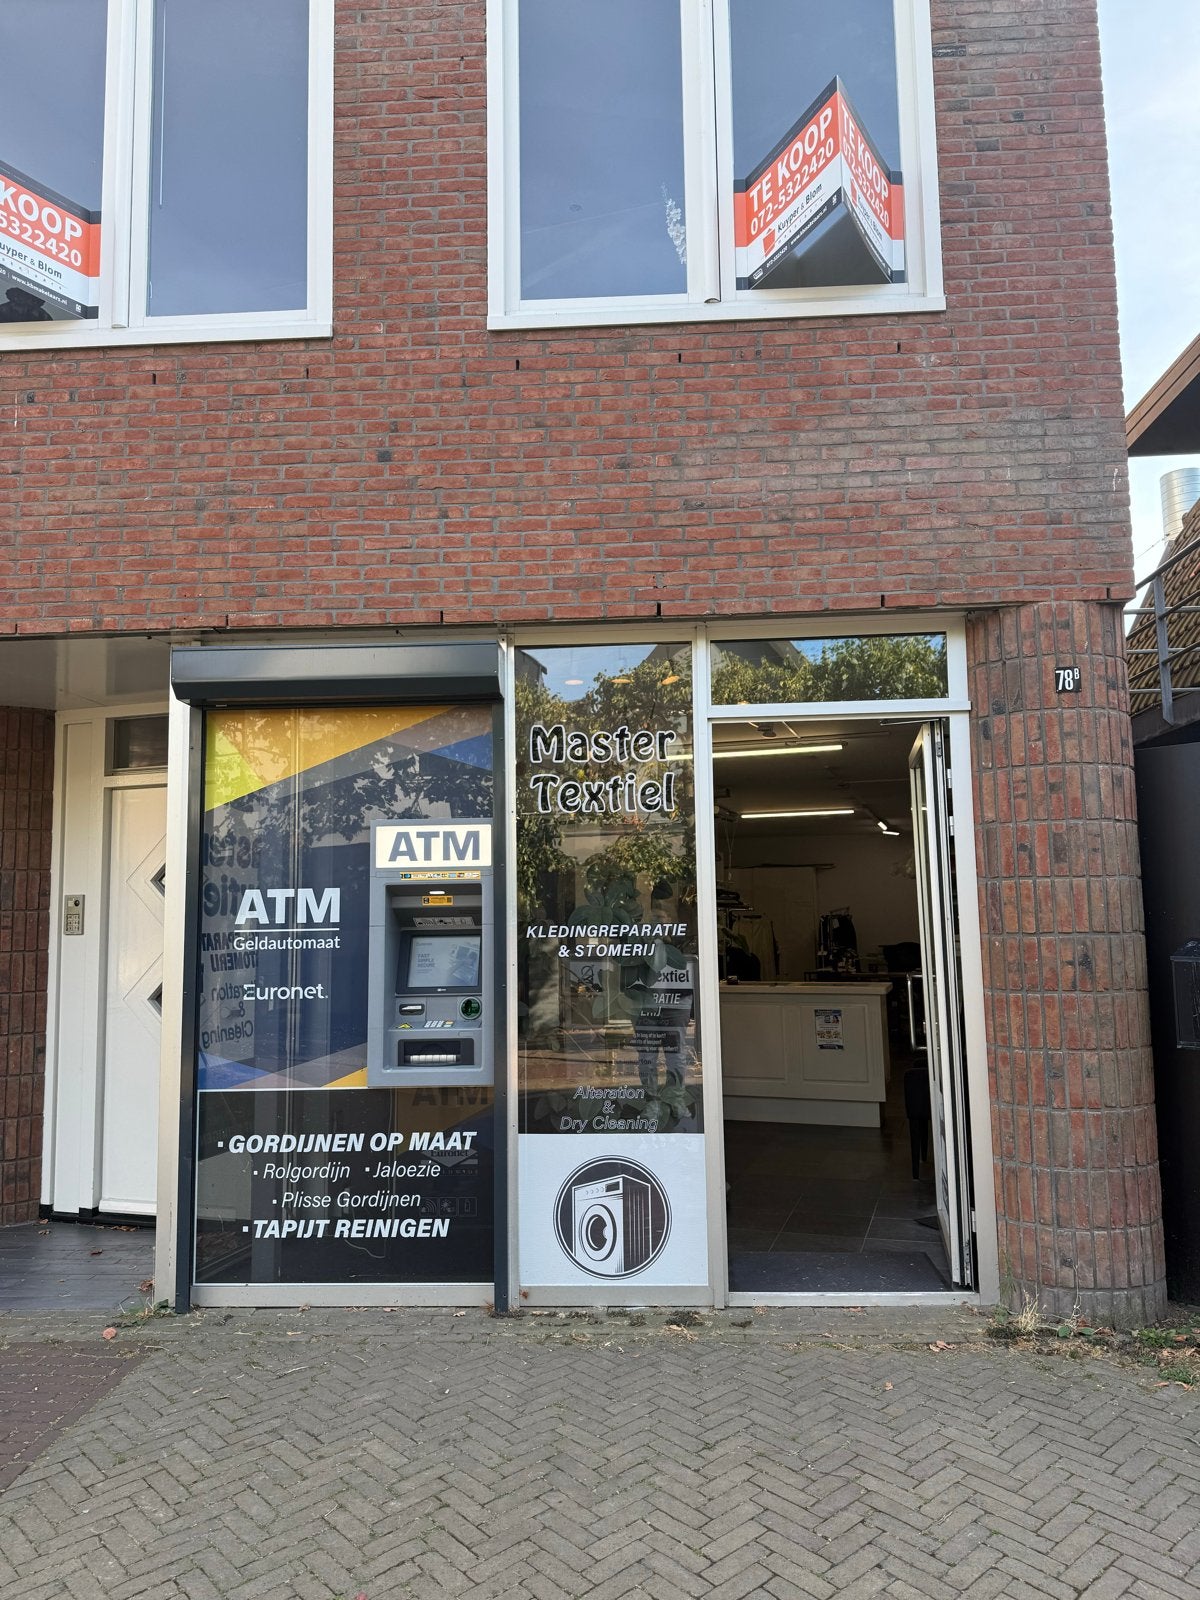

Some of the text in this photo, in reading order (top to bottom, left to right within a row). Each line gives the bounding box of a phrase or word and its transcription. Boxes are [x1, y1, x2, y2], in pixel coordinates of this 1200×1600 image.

[750, 172, 772, 213] TE
[777, 107, 832, 187] KOOP
[842, 104, 854, 150] TE
[858, 136, 889, 199] KOOP
[751, 137, 834, 235] 072-5322420
[0, 181, 82, 242] KOOP
[38, 260, 62, 279] Blom
[530, 724, 676, 763] Master
[529, 772, 675, 813] Textiel
[388, 830, 480, 862] ATM
[234, 887, 340, 925] ATM
[526, 924, 687, 938] KLEDINGREPARATIE
[233, 935, 340, 952] Geldautomaat
[558, 944, 655, 957] & STOMERIJ
[573, 1085, 645, 1100] Alteration
[602, 1101, 615, 1114] &
[560, 1115, 658, 1133] Dry Cleaning
[228, 1131, 477, 1153] GORDIJNEN OP MAAT
[263, 1160, 441, 1182] Rolgordijn Jaloezie
[282, 1190, 421, 1211] Plisse Gordijnen
[253, 1218, 450, 1239] TAPIJT REINIGEN
